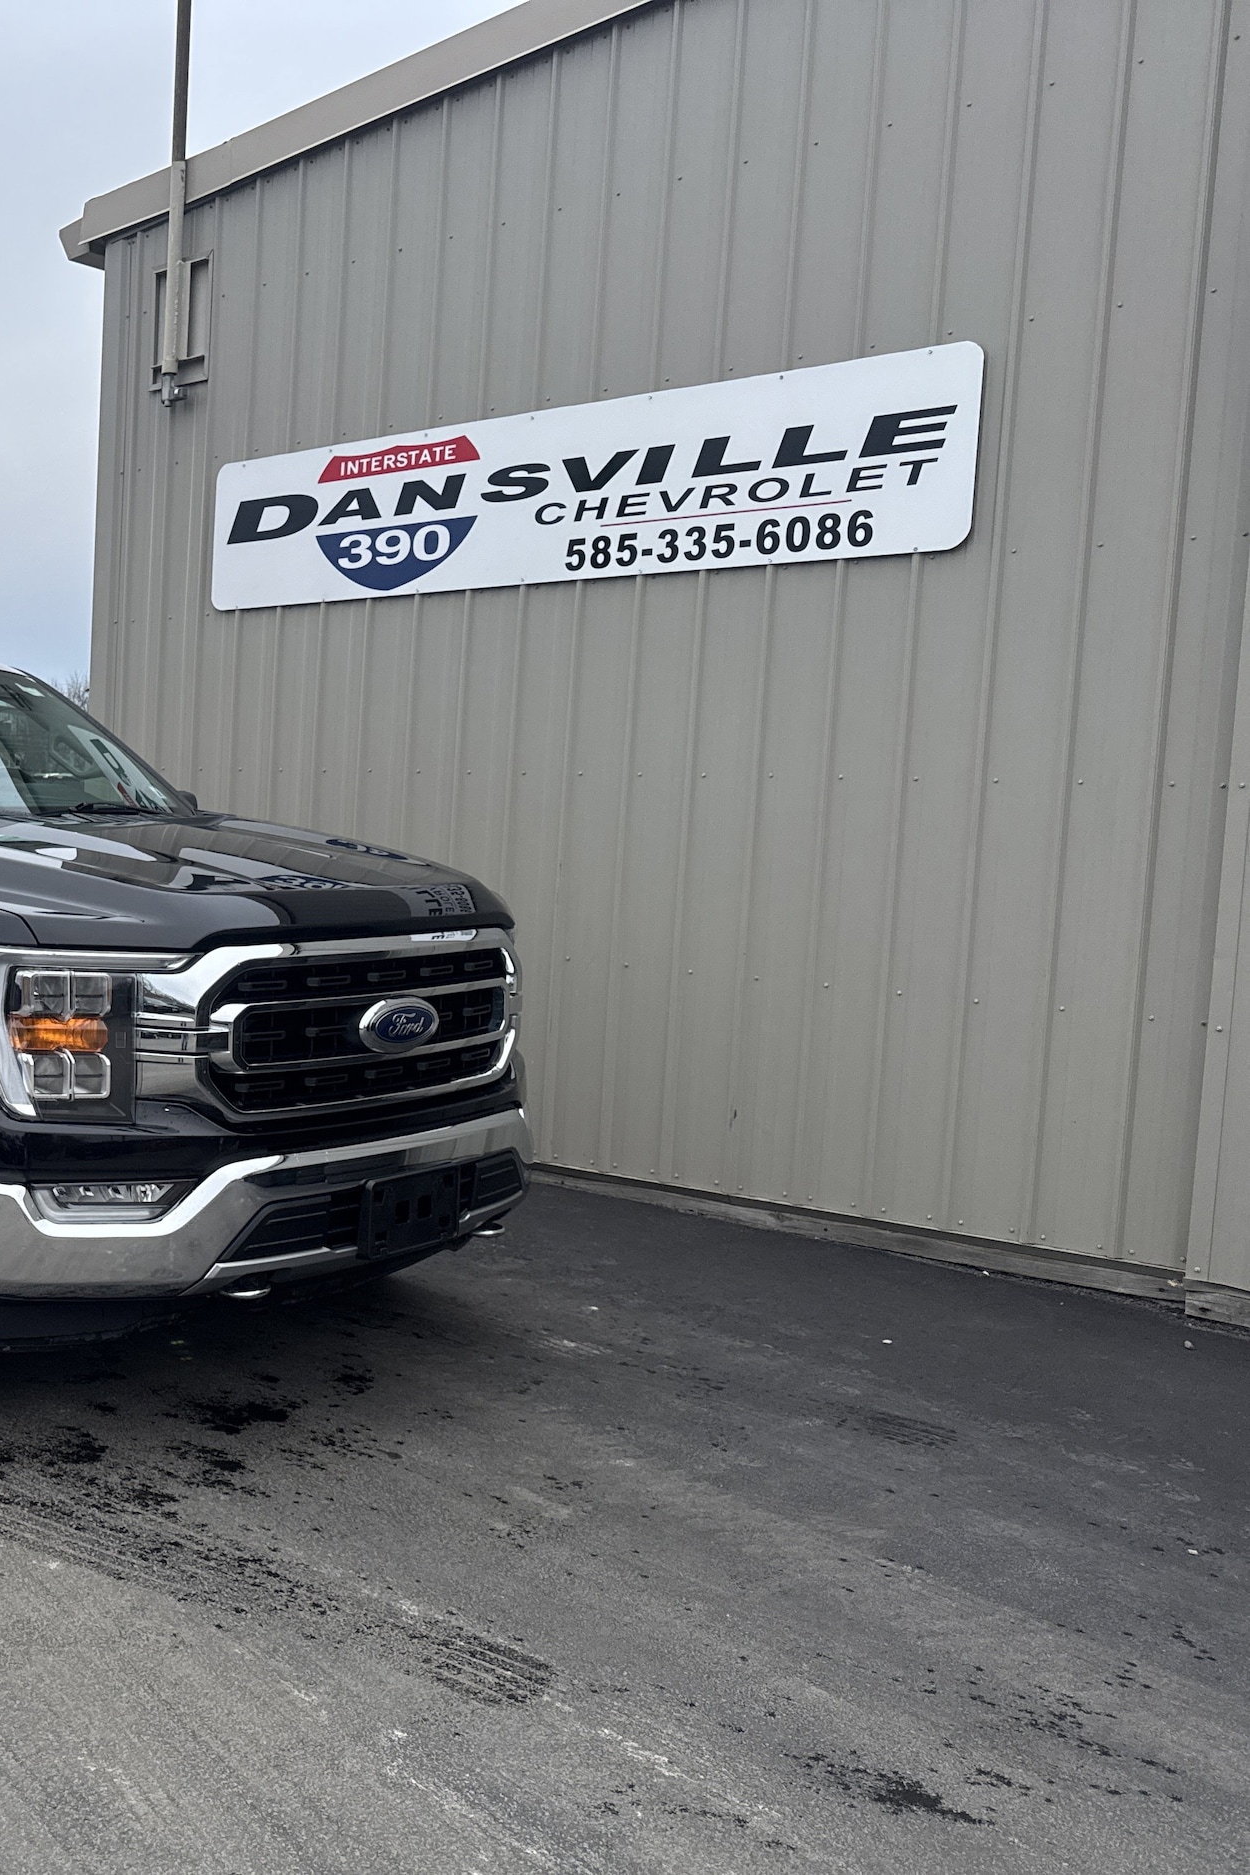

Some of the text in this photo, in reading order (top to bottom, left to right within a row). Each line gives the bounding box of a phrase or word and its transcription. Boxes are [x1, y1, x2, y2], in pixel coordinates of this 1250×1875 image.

[339, 443, 456, 477] INTERSTATE
[535, 457, 939, 526] CHEVROLET
[338, 523, 452, 570] 390
[564, 510, 875, 572] 585-335-6086
[388, 1012, 425, 1038] Ford
